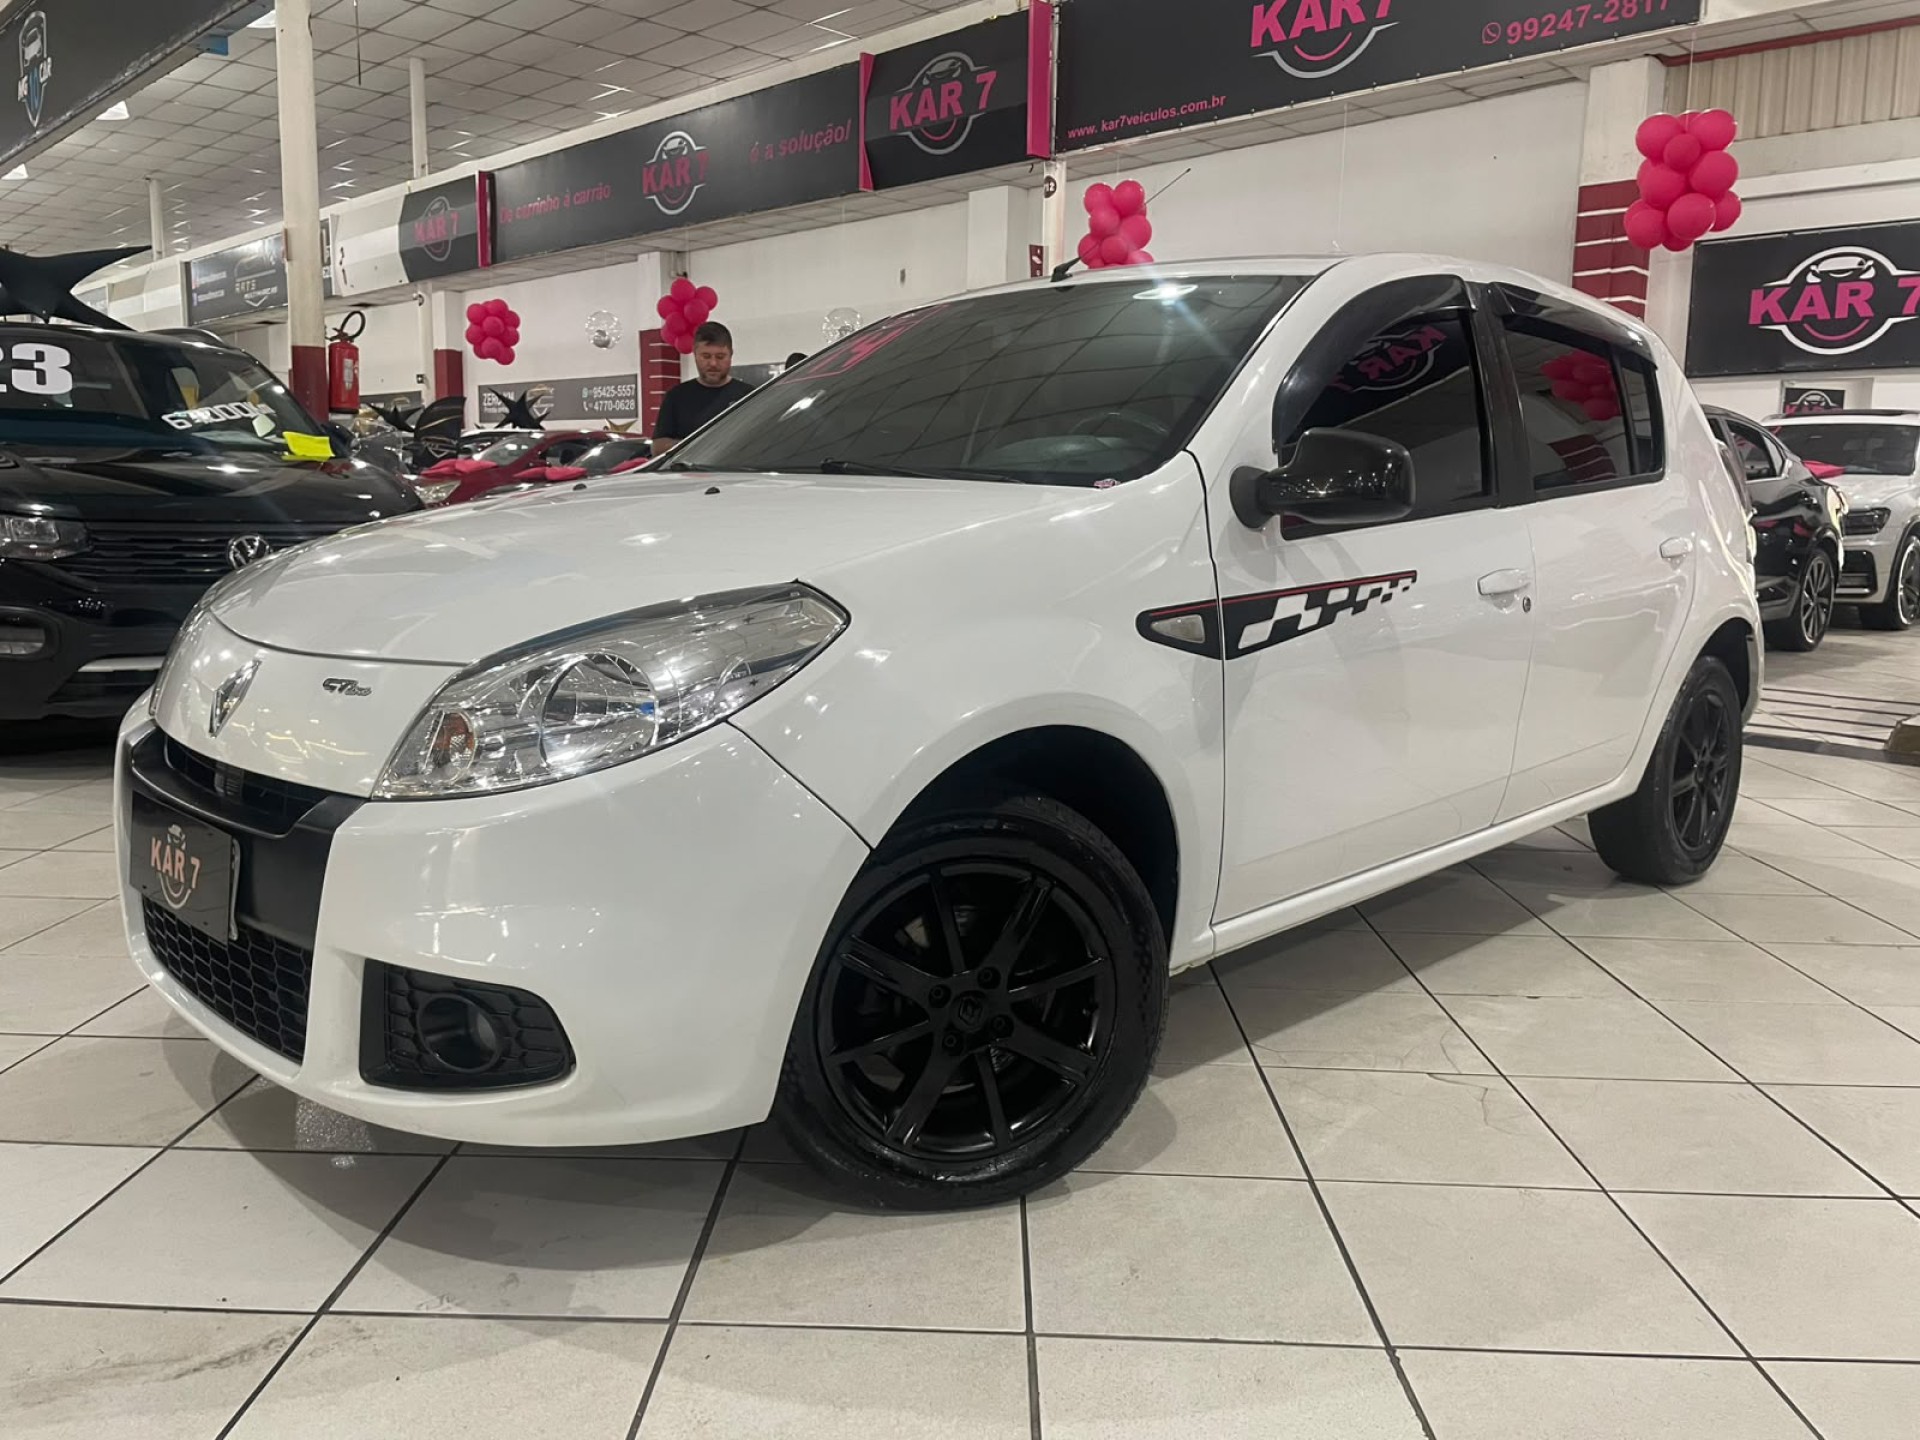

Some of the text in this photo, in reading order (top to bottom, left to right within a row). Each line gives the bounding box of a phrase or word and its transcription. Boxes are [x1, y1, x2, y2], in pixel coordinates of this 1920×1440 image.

[1251, 0, 1366, 47] KAR
[889, 70, 998, 131] KAR 7
[1067, 95, 1226, 138] www. kar7veiculos.com.br
[778, 120, 852, 157] solução!
[641, 150, 710, 196] KAR 7
[414, 212, 447, 243] KAR
[1748, 276, 1920, 325] KAR 7
[0, 343, 73, 394] 3
[151, 837, 200, 889] KAR 7
